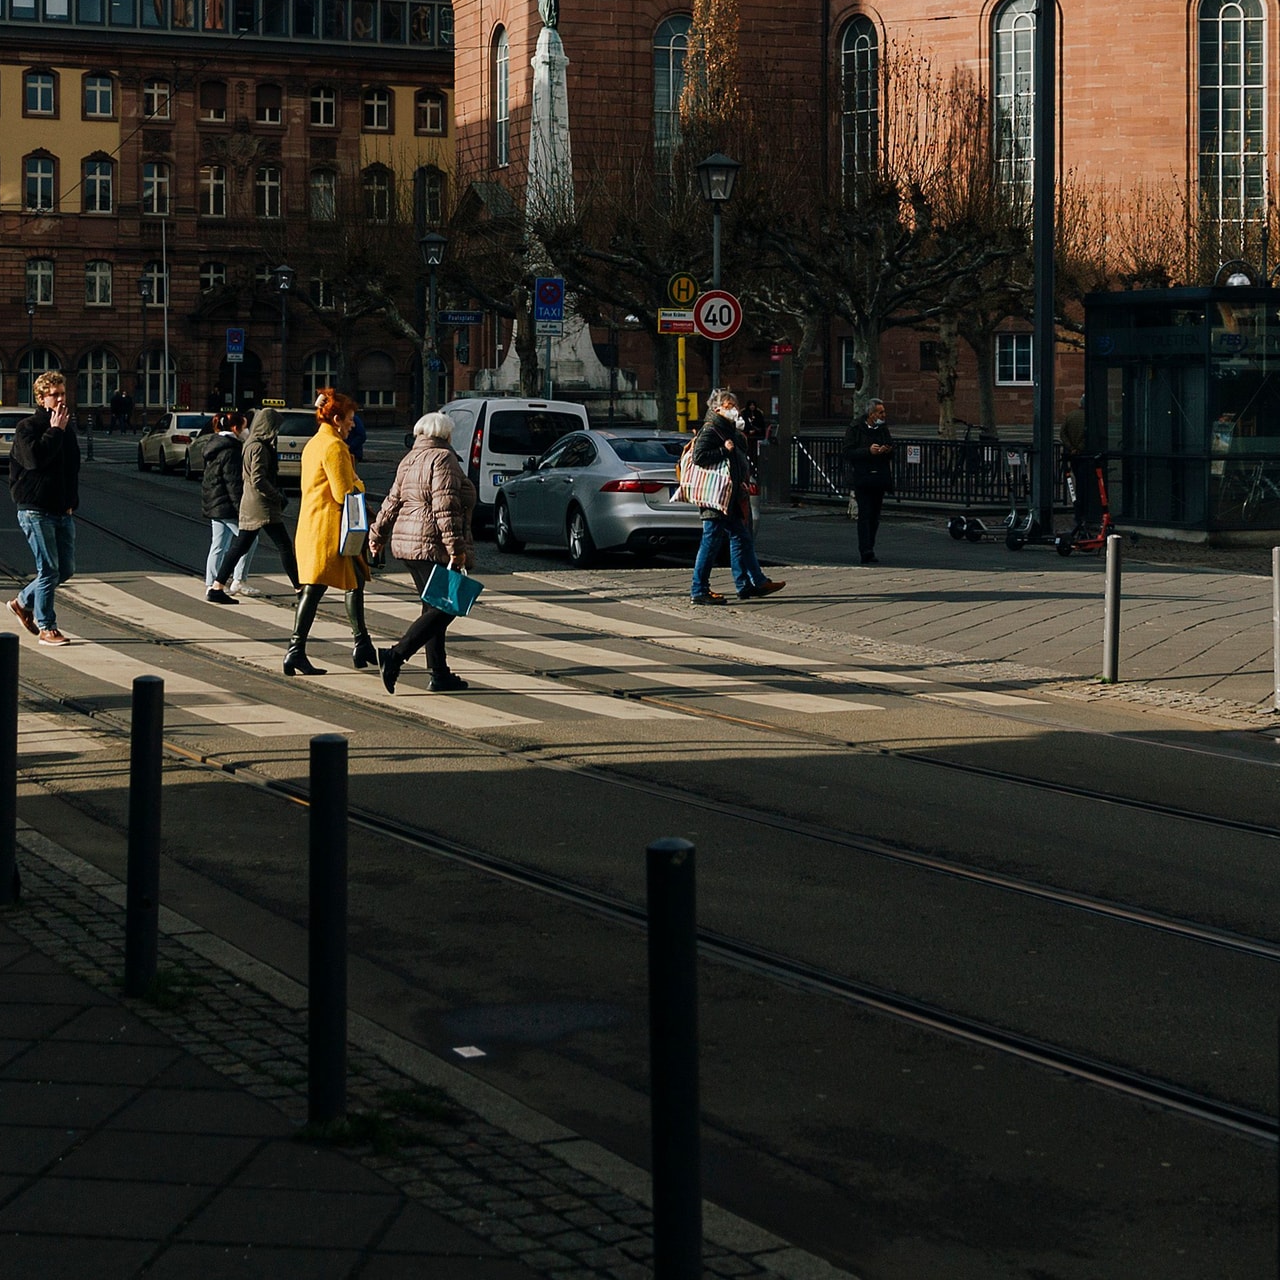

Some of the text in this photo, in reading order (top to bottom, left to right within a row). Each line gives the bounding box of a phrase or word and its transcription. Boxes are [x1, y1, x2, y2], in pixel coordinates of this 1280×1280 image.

[538, 307, 560, 317] TAXI
[704, 304, 732, 326] 40
[1220, 333, 1241, 345] FES
